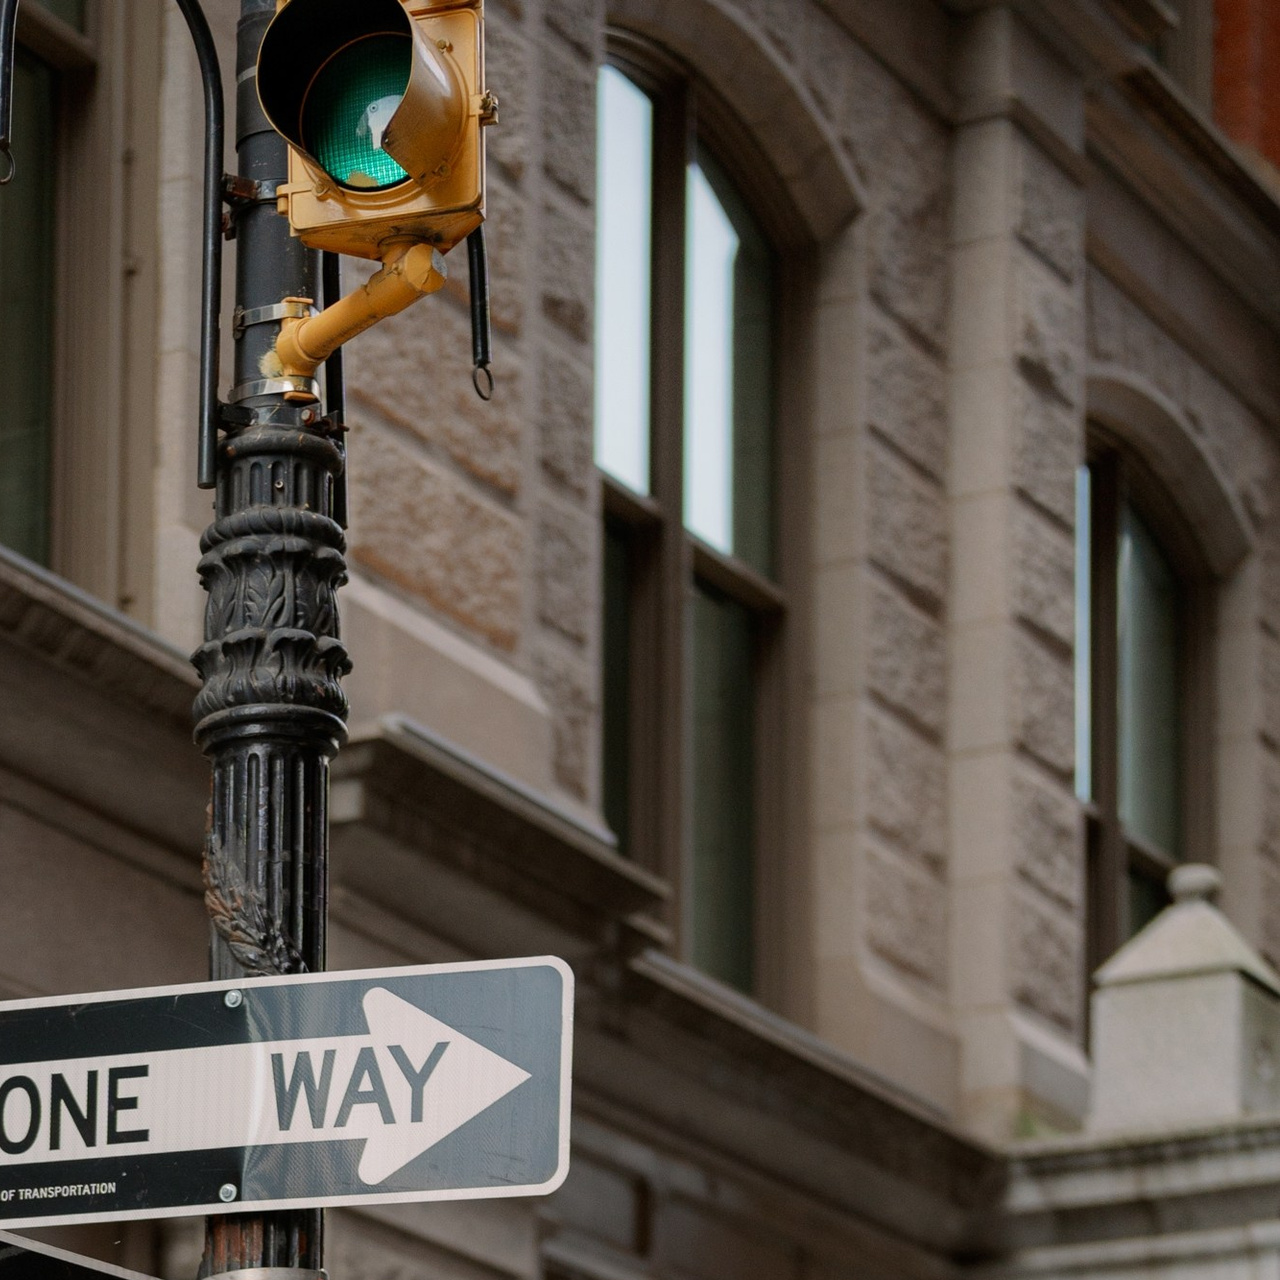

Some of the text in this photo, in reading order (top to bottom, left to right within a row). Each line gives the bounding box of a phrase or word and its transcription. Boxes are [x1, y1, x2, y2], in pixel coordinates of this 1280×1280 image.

[270, 1041, 451, 1132] WAY
[0, 1189, 16, 1202] OF
[18, 1182, 117, 1200] TRANSPORTATION
